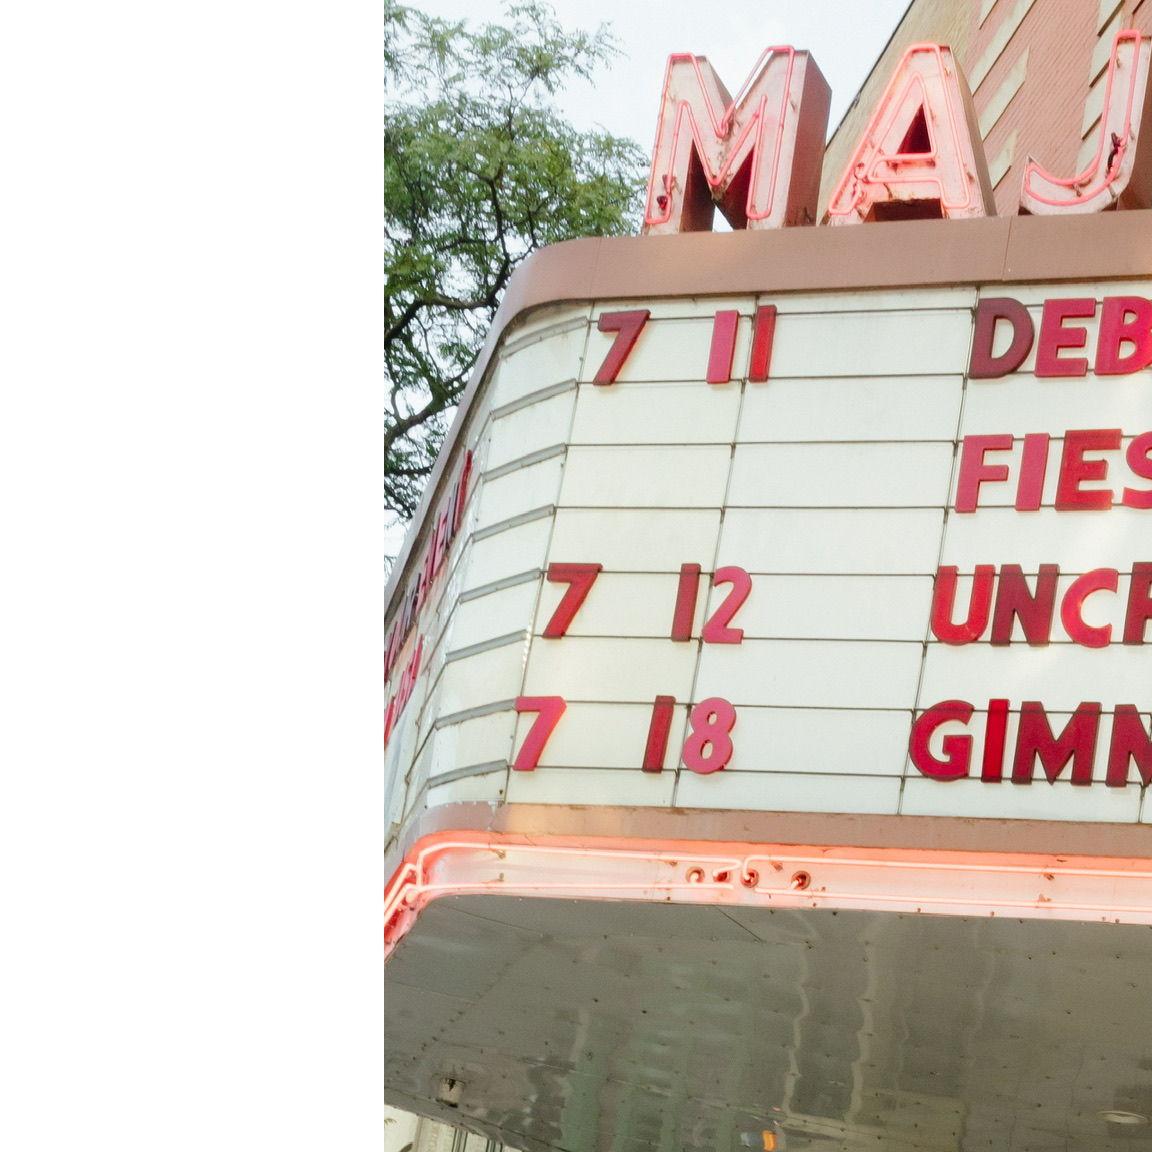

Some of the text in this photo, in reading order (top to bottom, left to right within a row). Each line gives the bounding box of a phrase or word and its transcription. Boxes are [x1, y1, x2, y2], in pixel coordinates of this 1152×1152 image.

[593, 309, 650, 386] 7
[706, 305, 777, 385] 11
[543, 562, 602, 639] 7
[671, 563, 752, 645] 12
[512, 695, 567, 773] 7
[641, 695, 737, 775] 18
